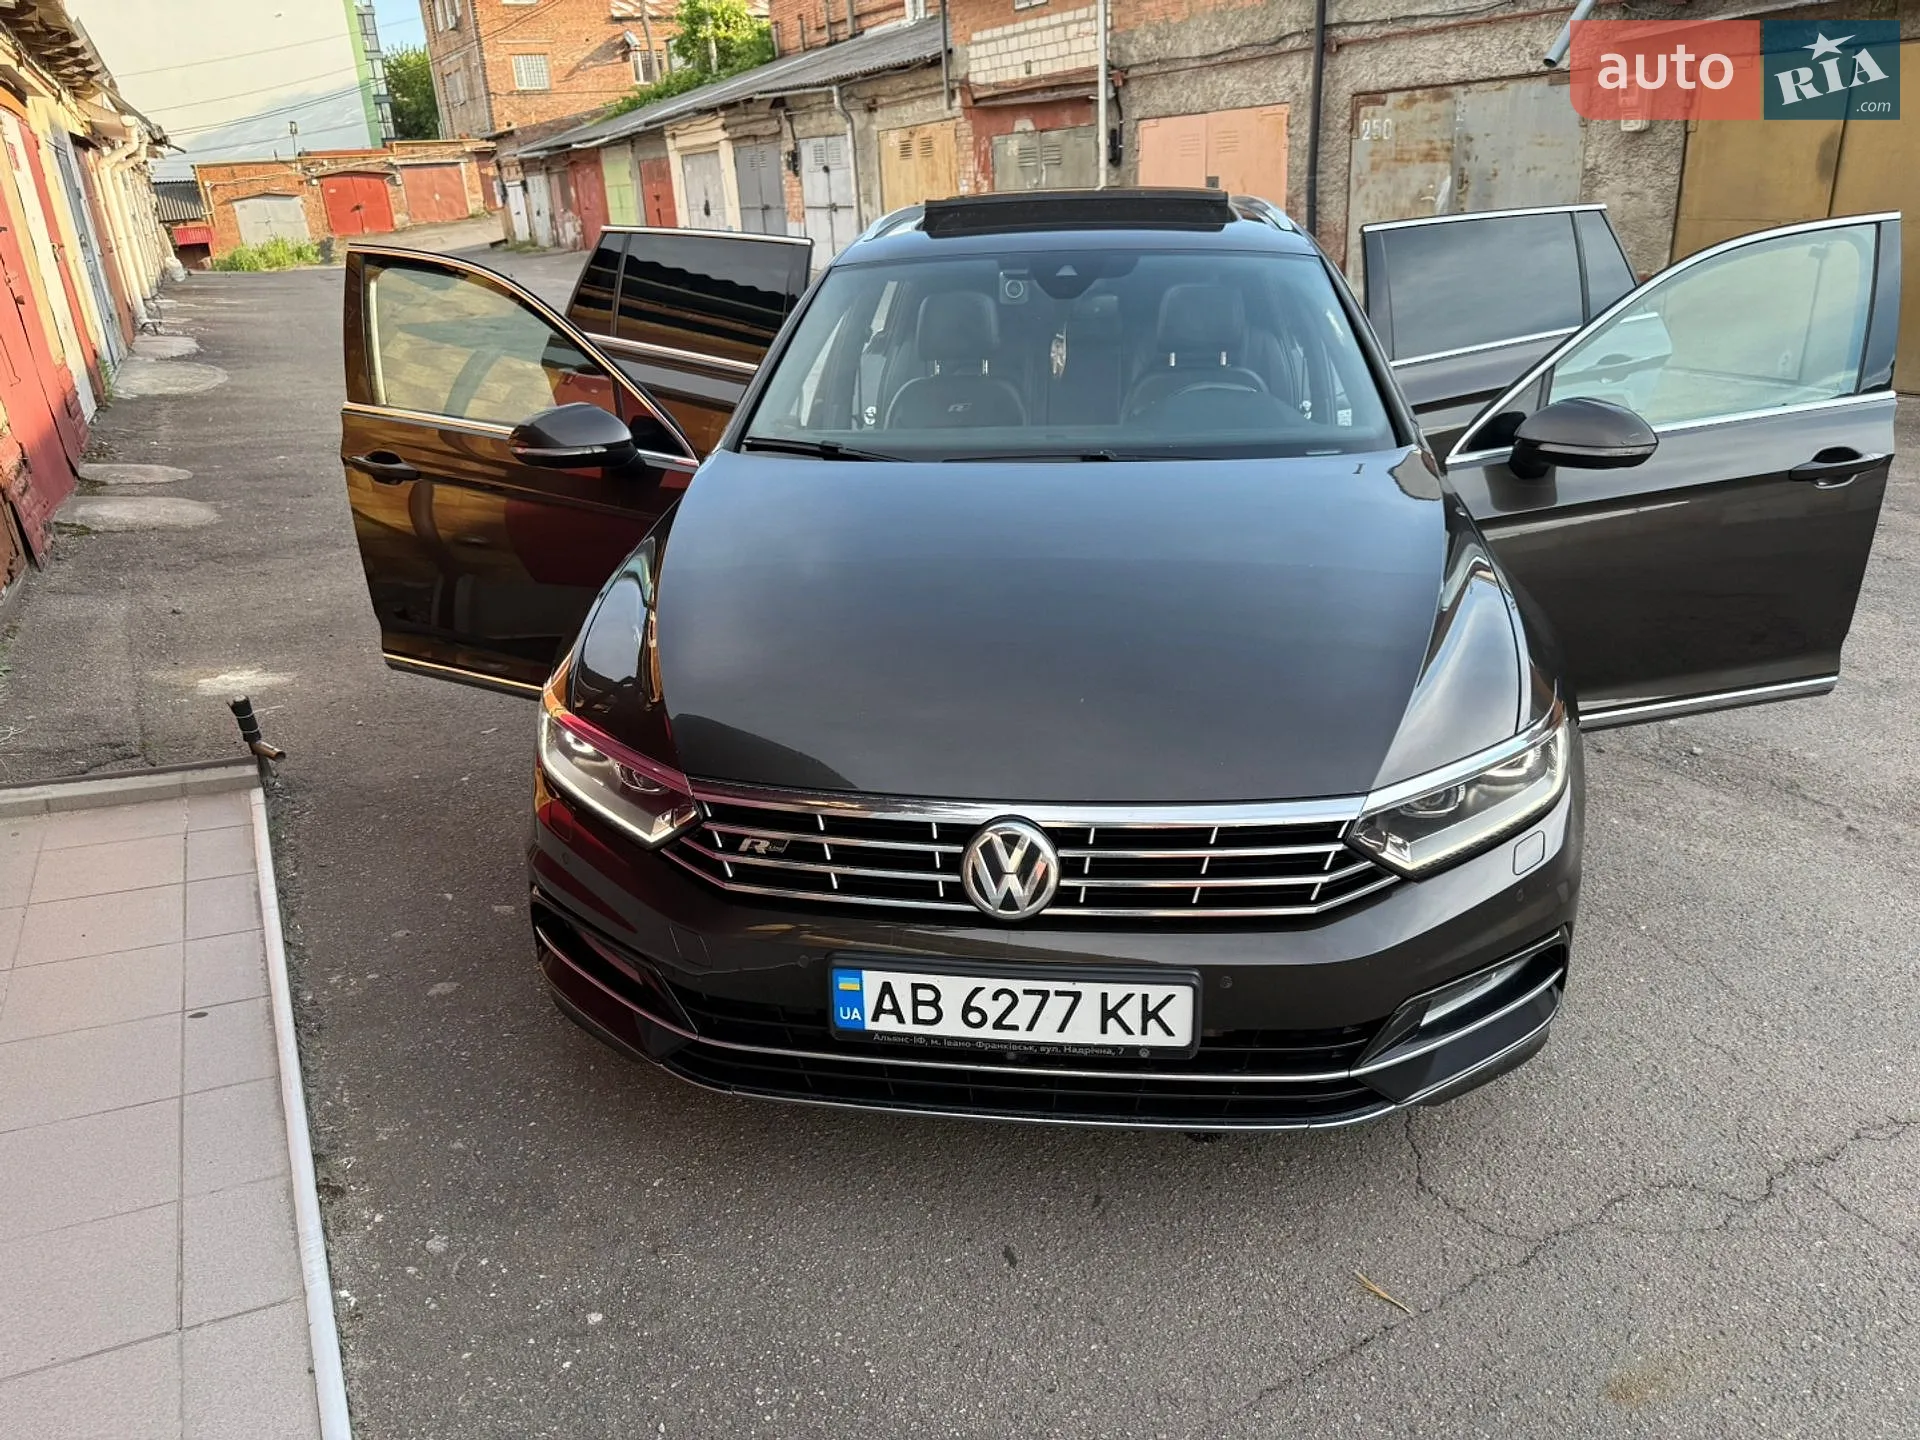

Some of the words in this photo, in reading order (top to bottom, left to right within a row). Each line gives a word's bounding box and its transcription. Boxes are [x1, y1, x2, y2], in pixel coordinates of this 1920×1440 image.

[1362, 118, 1392, 141] 250
[840, 1007, 862, 1021] UA
[870, 981, 944, 1026] AB
[961, 986, 1083, 1033] 6277
[1100, 992, 1176, 1036] KK
